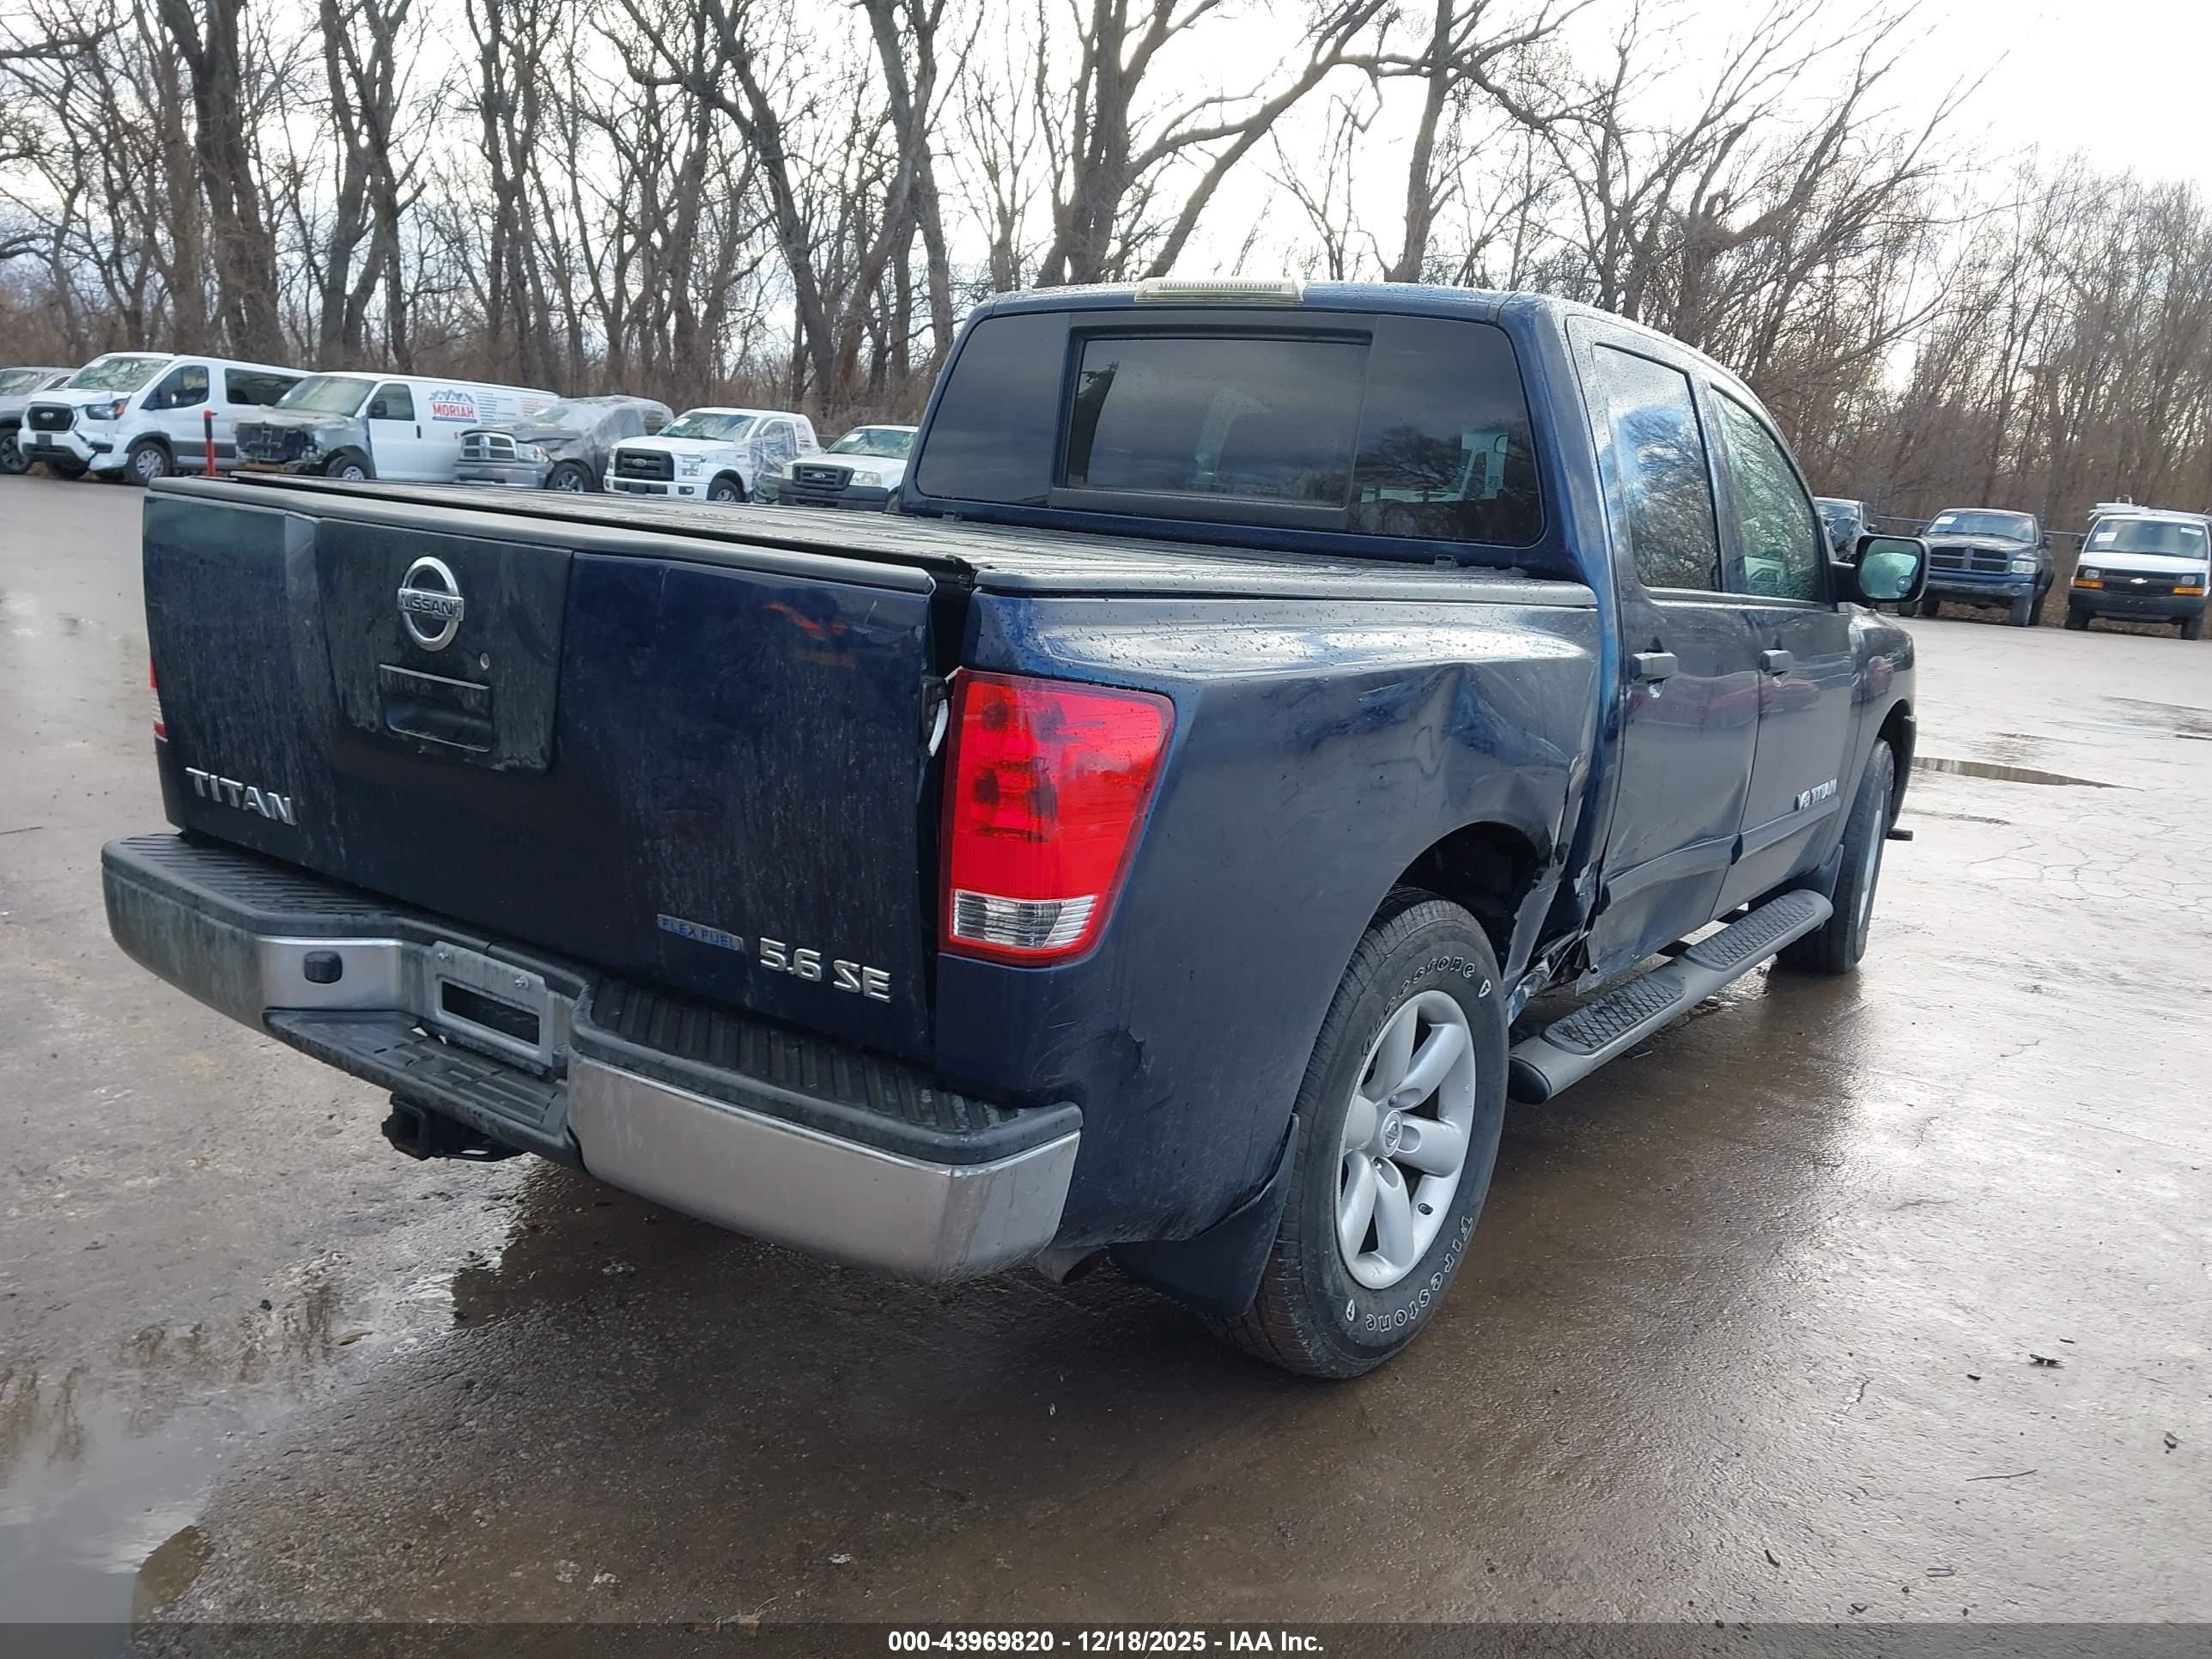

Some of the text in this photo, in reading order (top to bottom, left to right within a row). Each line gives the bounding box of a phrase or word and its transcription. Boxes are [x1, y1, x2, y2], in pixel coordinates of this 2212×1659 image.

[432, 403, 475, 418] MORIAH
[401, 594, 454, 616] NISSAN
[185, 766, 297, 826] TITAN
[1811, 777, 1838, 805] TITAN
[662, 917, 740, 951] FLEX FUEL
[759, 936, 891, 1004] 5.6 SE
[1365, 1215, 1474, 1333] Firestone
